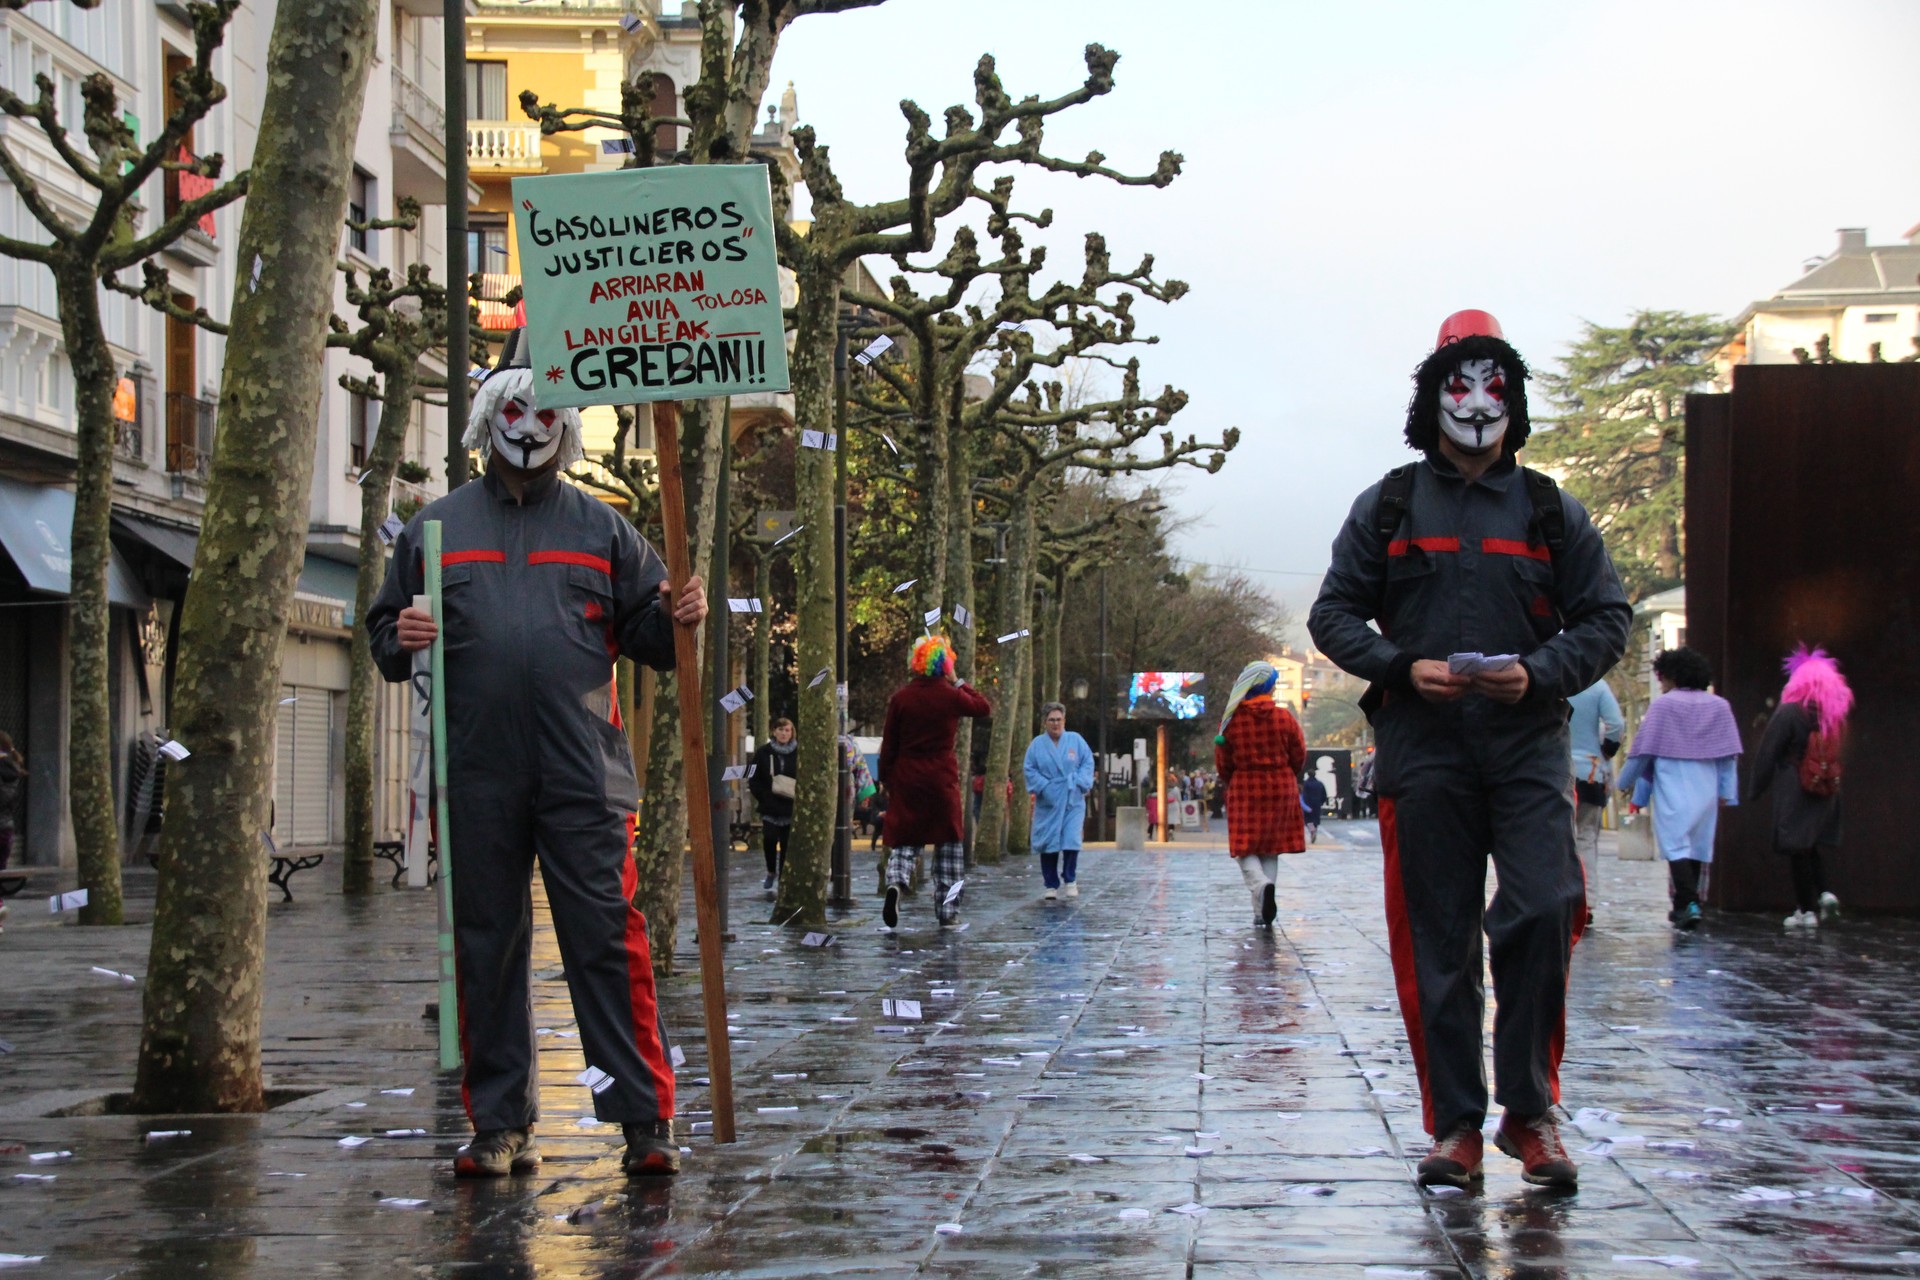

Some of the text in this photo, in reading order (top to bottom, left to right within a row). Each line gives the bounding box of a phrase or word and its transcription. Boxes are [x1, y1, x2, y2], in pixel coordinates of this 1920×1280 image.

[589, 269, 705, 304] ARRIARAN
[626, 287, 768, 323] AVIA TOLOSA
[564, 320, 709, 351] LANGILEAK
[570, 339, 766, 391] GREBAN!!
